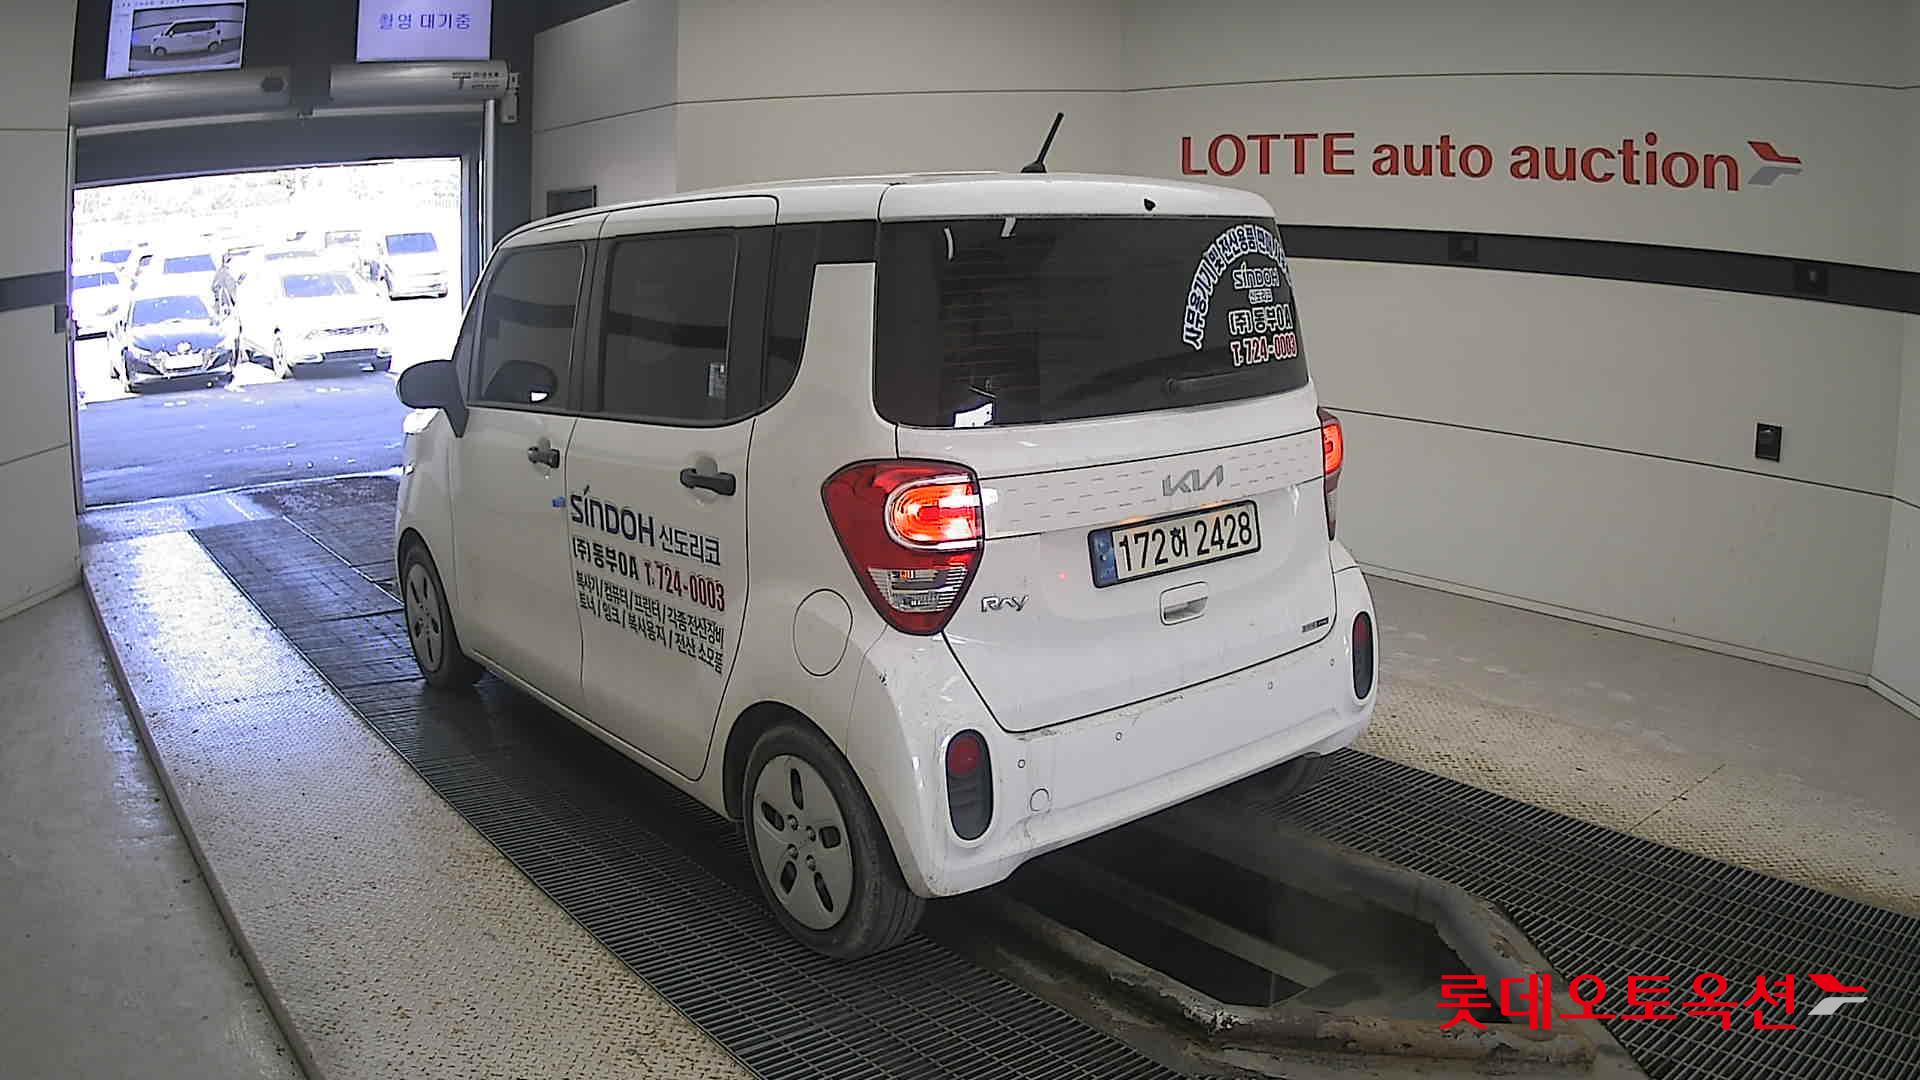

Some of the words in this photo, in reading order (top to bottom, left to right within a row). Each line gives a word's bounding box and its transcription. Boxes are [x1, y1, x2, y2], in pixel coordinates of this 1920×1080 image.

[420, 13, 472, 30] 대기중
[1180, 132, 1356, 177] LOTTE
[1371, 136, 1494, 179] auto
[1509, 132, 1740, 191] auction
[1161, 465, 1224, 497] KIA
[659, 525, 721, 566] 신도리코
